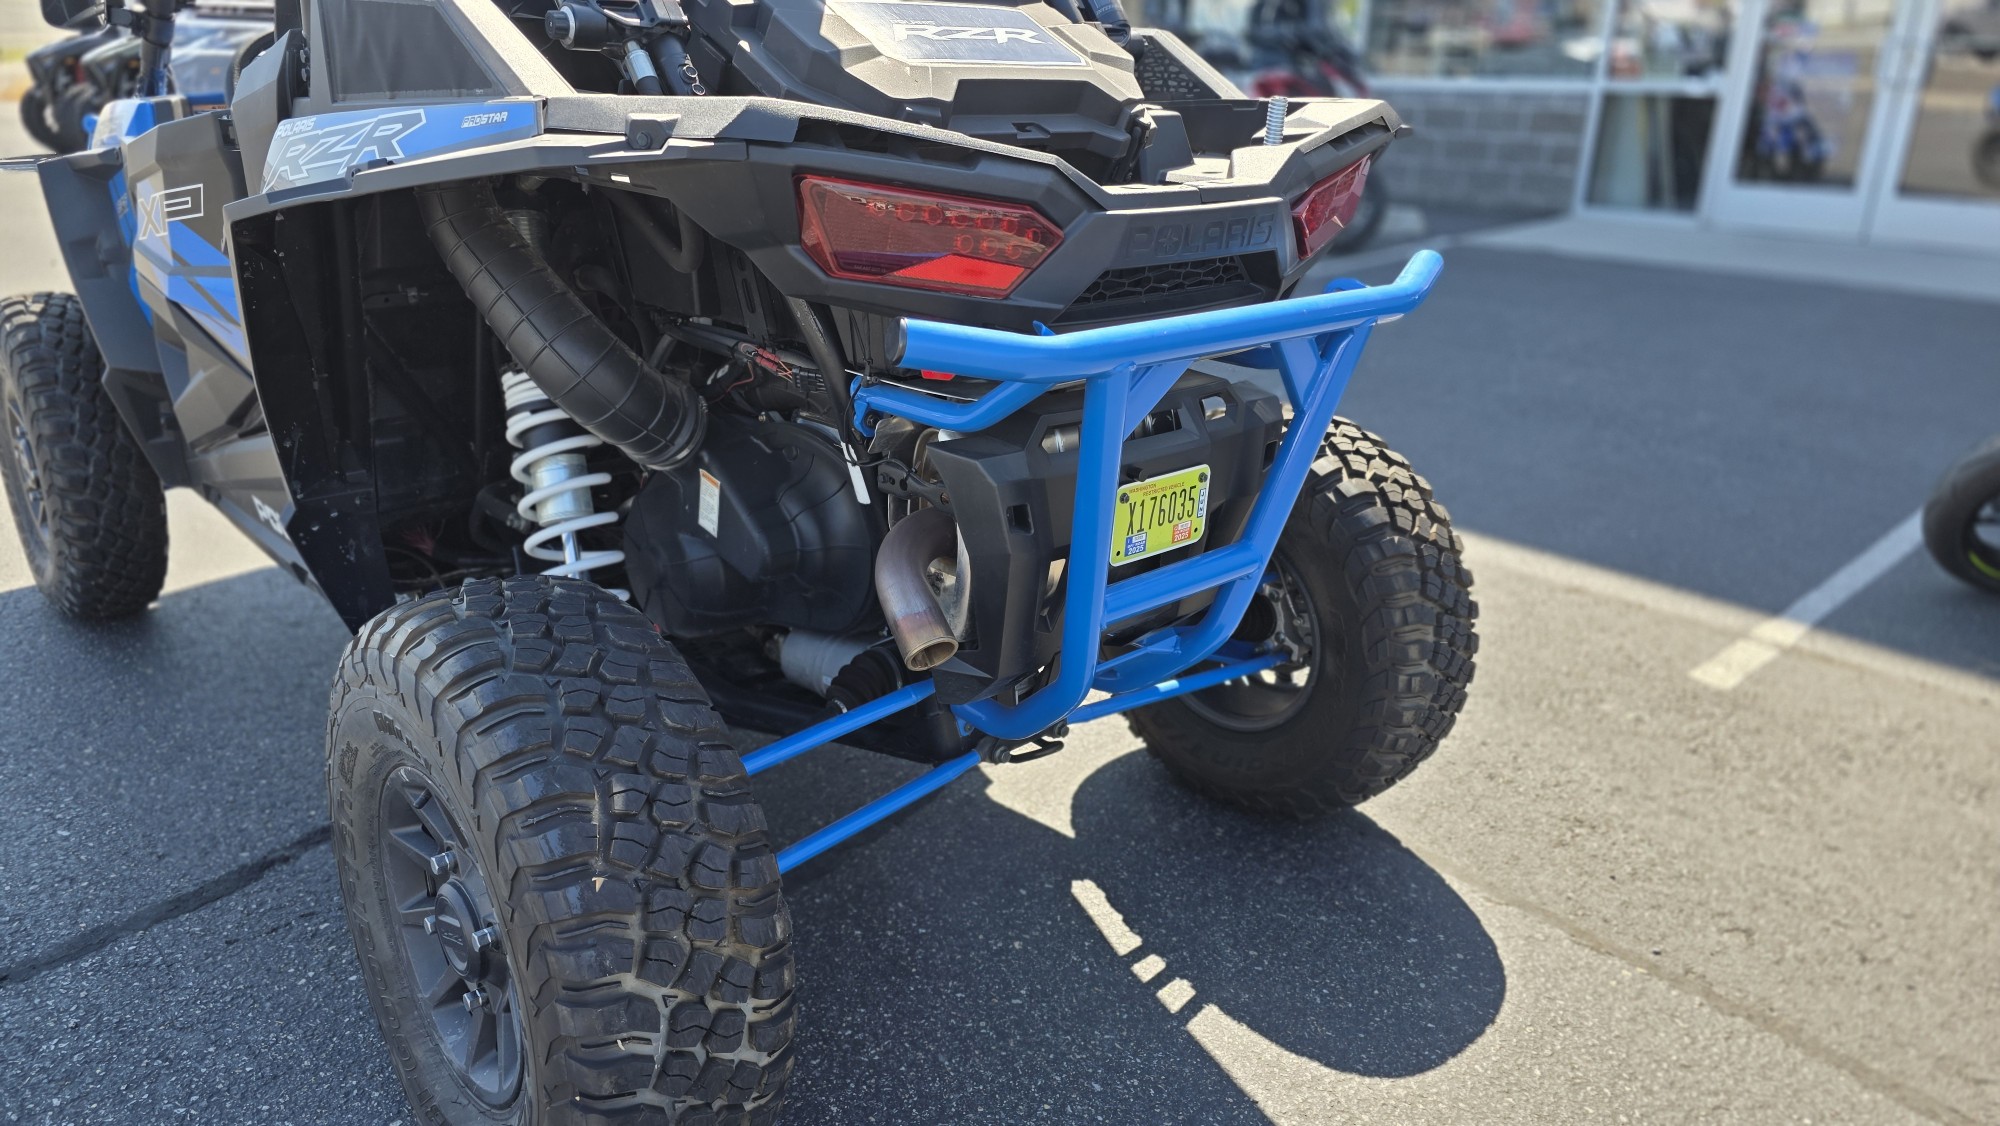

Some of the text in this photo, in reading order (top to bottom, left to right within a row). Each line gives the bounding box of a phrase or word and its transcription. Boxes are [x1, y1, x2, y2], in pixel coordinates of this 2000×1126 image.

[892, 24, 1053, 44] RZR
[275, 117, 317, 138] POLARIS
[461, 111, 508, 128] PROSTAR
[262, 108, 427, 194] RZR
[139, 183, 204, 240] XP
[1124, 214, 1274, 257] POLARIS
[1127, 485, 1197, 535] X176035
[1174, 532, 1189, 542] 2025
[1128, 545, 1145, 555] 2025
